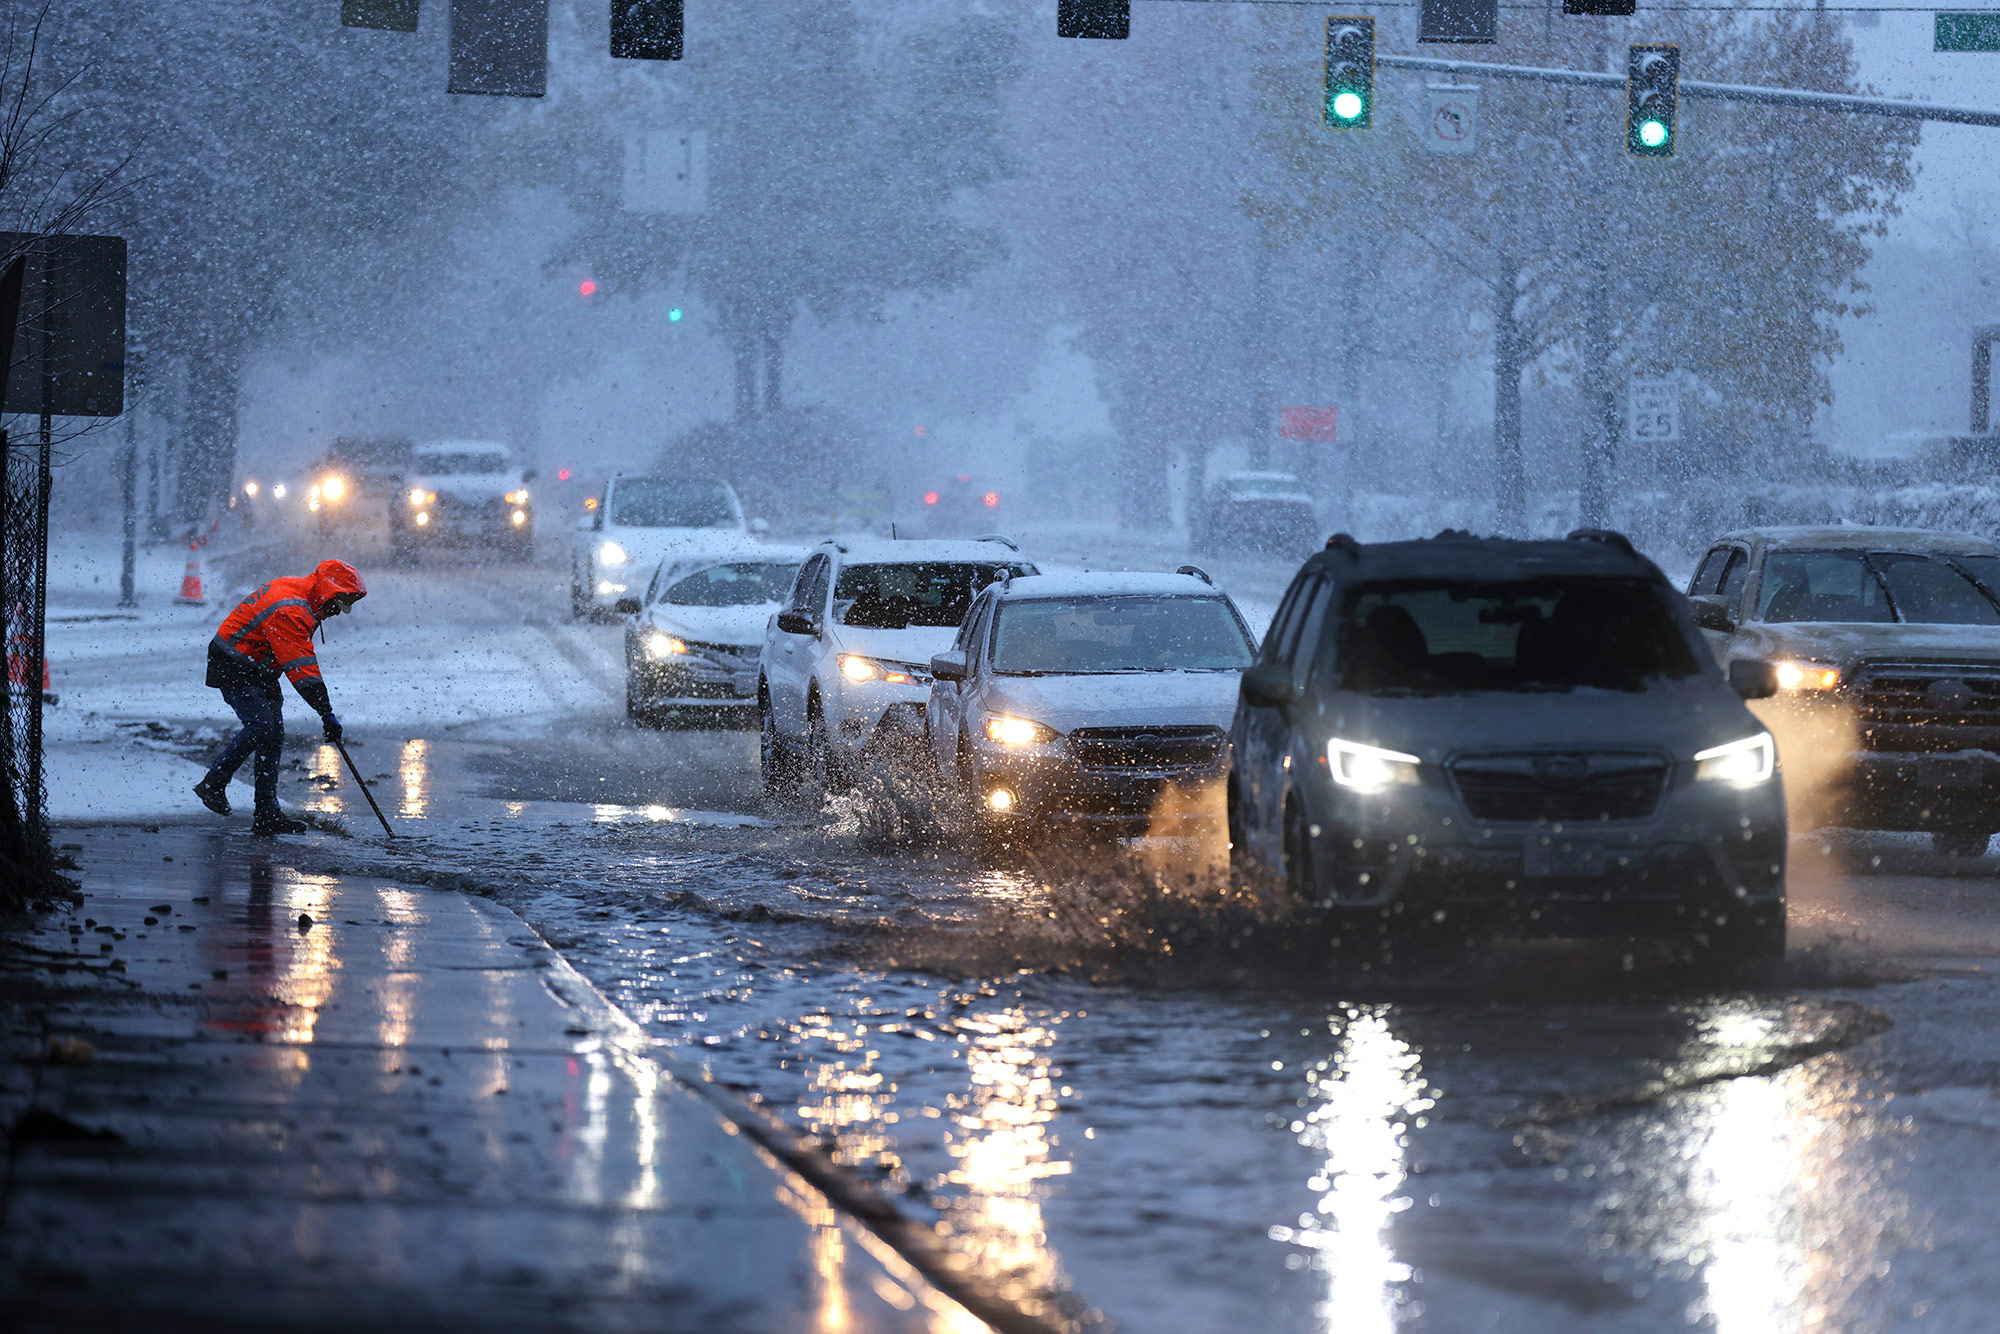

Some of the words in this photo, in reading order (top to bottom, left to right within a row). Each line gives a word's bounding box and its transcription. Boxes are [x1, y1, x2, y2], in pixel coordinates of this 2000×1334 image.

[1631, 384, 1677, 397] SPEED
[1636, 398, 1671, 411] LIMIT
[1636, 413, 1672, 438] 25
